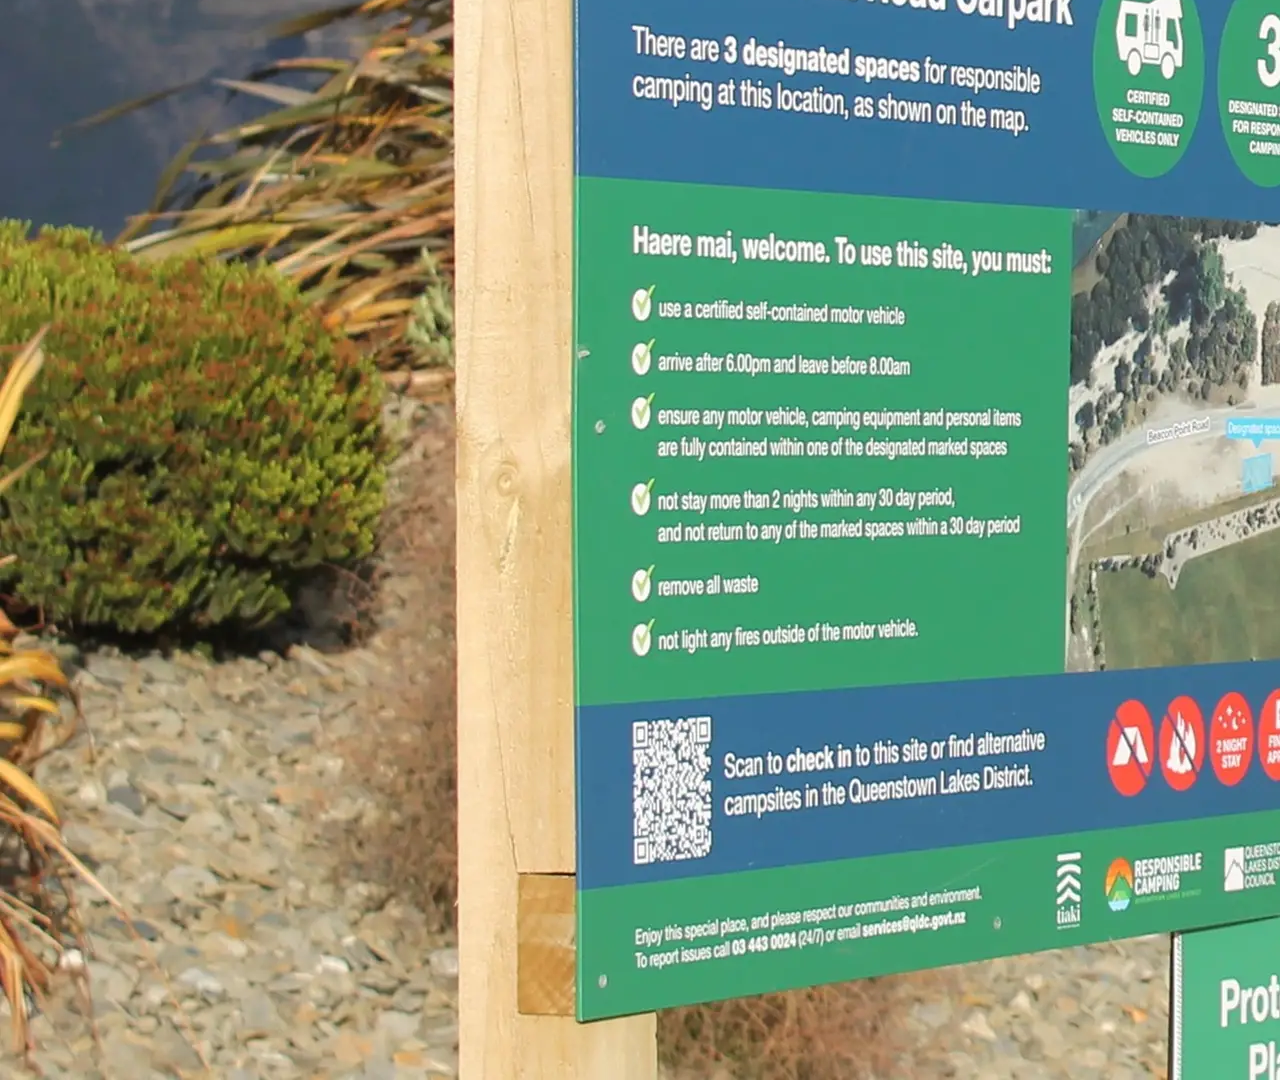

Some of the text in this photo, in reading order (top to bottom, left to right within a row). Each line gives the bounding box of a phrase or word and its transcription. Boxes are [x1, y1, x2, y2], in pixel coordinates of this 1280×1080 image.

[633, 25, 1041, 94] There are 3 designated spaces for responsible
[633, 76, 1029, 137] camping at this location, as shown on the map.
[1127, 89, 1171, 107] CERTIFIED
[1229, 100, 1279, 118] DESIGNATED
[1113, 108, 1184, 128] SELF-CONTAINED
[1233, 120, 1251, 134] FOR
[1116, 128, 1181, 147] VEHICLES ONLY
[633, 225, 1053, 276] Haere mai, welcome. To use this site, you must:
[659, 300, 906, 325] use a certified self-contained motor vehicle
[659, 352, 911, 377] arrive after 6.00pm and leave before 8.00am
[658, 407, 1023, 430] ensure any motor vehicle, camping equipment and personal items
[658, 438, 1008, 461] are fully contained within one of the designated marked spaces
[658, 487, 956, 514] not stay more than 2 nights within any 30 day period,
[658, 516, 1021, 543] and not return to any of the marked spaces within a 30 day period
[658, 575, 760, 596] remove all waste
[659, 619, 919, 654] not light any fires outside of the motor vehicle.
[725, 729, 1046, 779] Scan to check in to this site or find alternative
[1216, 737, 1248, 754] 2 NIGHT
[1222, 754, 1242, 769] STAY
[725, 764, 1034, 818] campsites in the Queenstown Lakes District.
[1134, 852, 1202, 877] RESPONSIBLE
[1244, 857, 1266, 873] LAKES
[1134, 873, 1180, 896] CAMPING
[1244, 872, 1276, 889] COUNCIL
[1057, 904, 1081, 925] tiaki
[635, 952, 649, 969] To
[649, 949, 680, 968] report
[681, 947, 713, 963] issues
[713, 941, 731, 958] call
[732, 939, 748, 956] 03
[747, 936, 770, 953] 443
[770, 932, 798, 950] 0024
[825, 930, 837, 942] or
[837, 923, 862, 941] email
